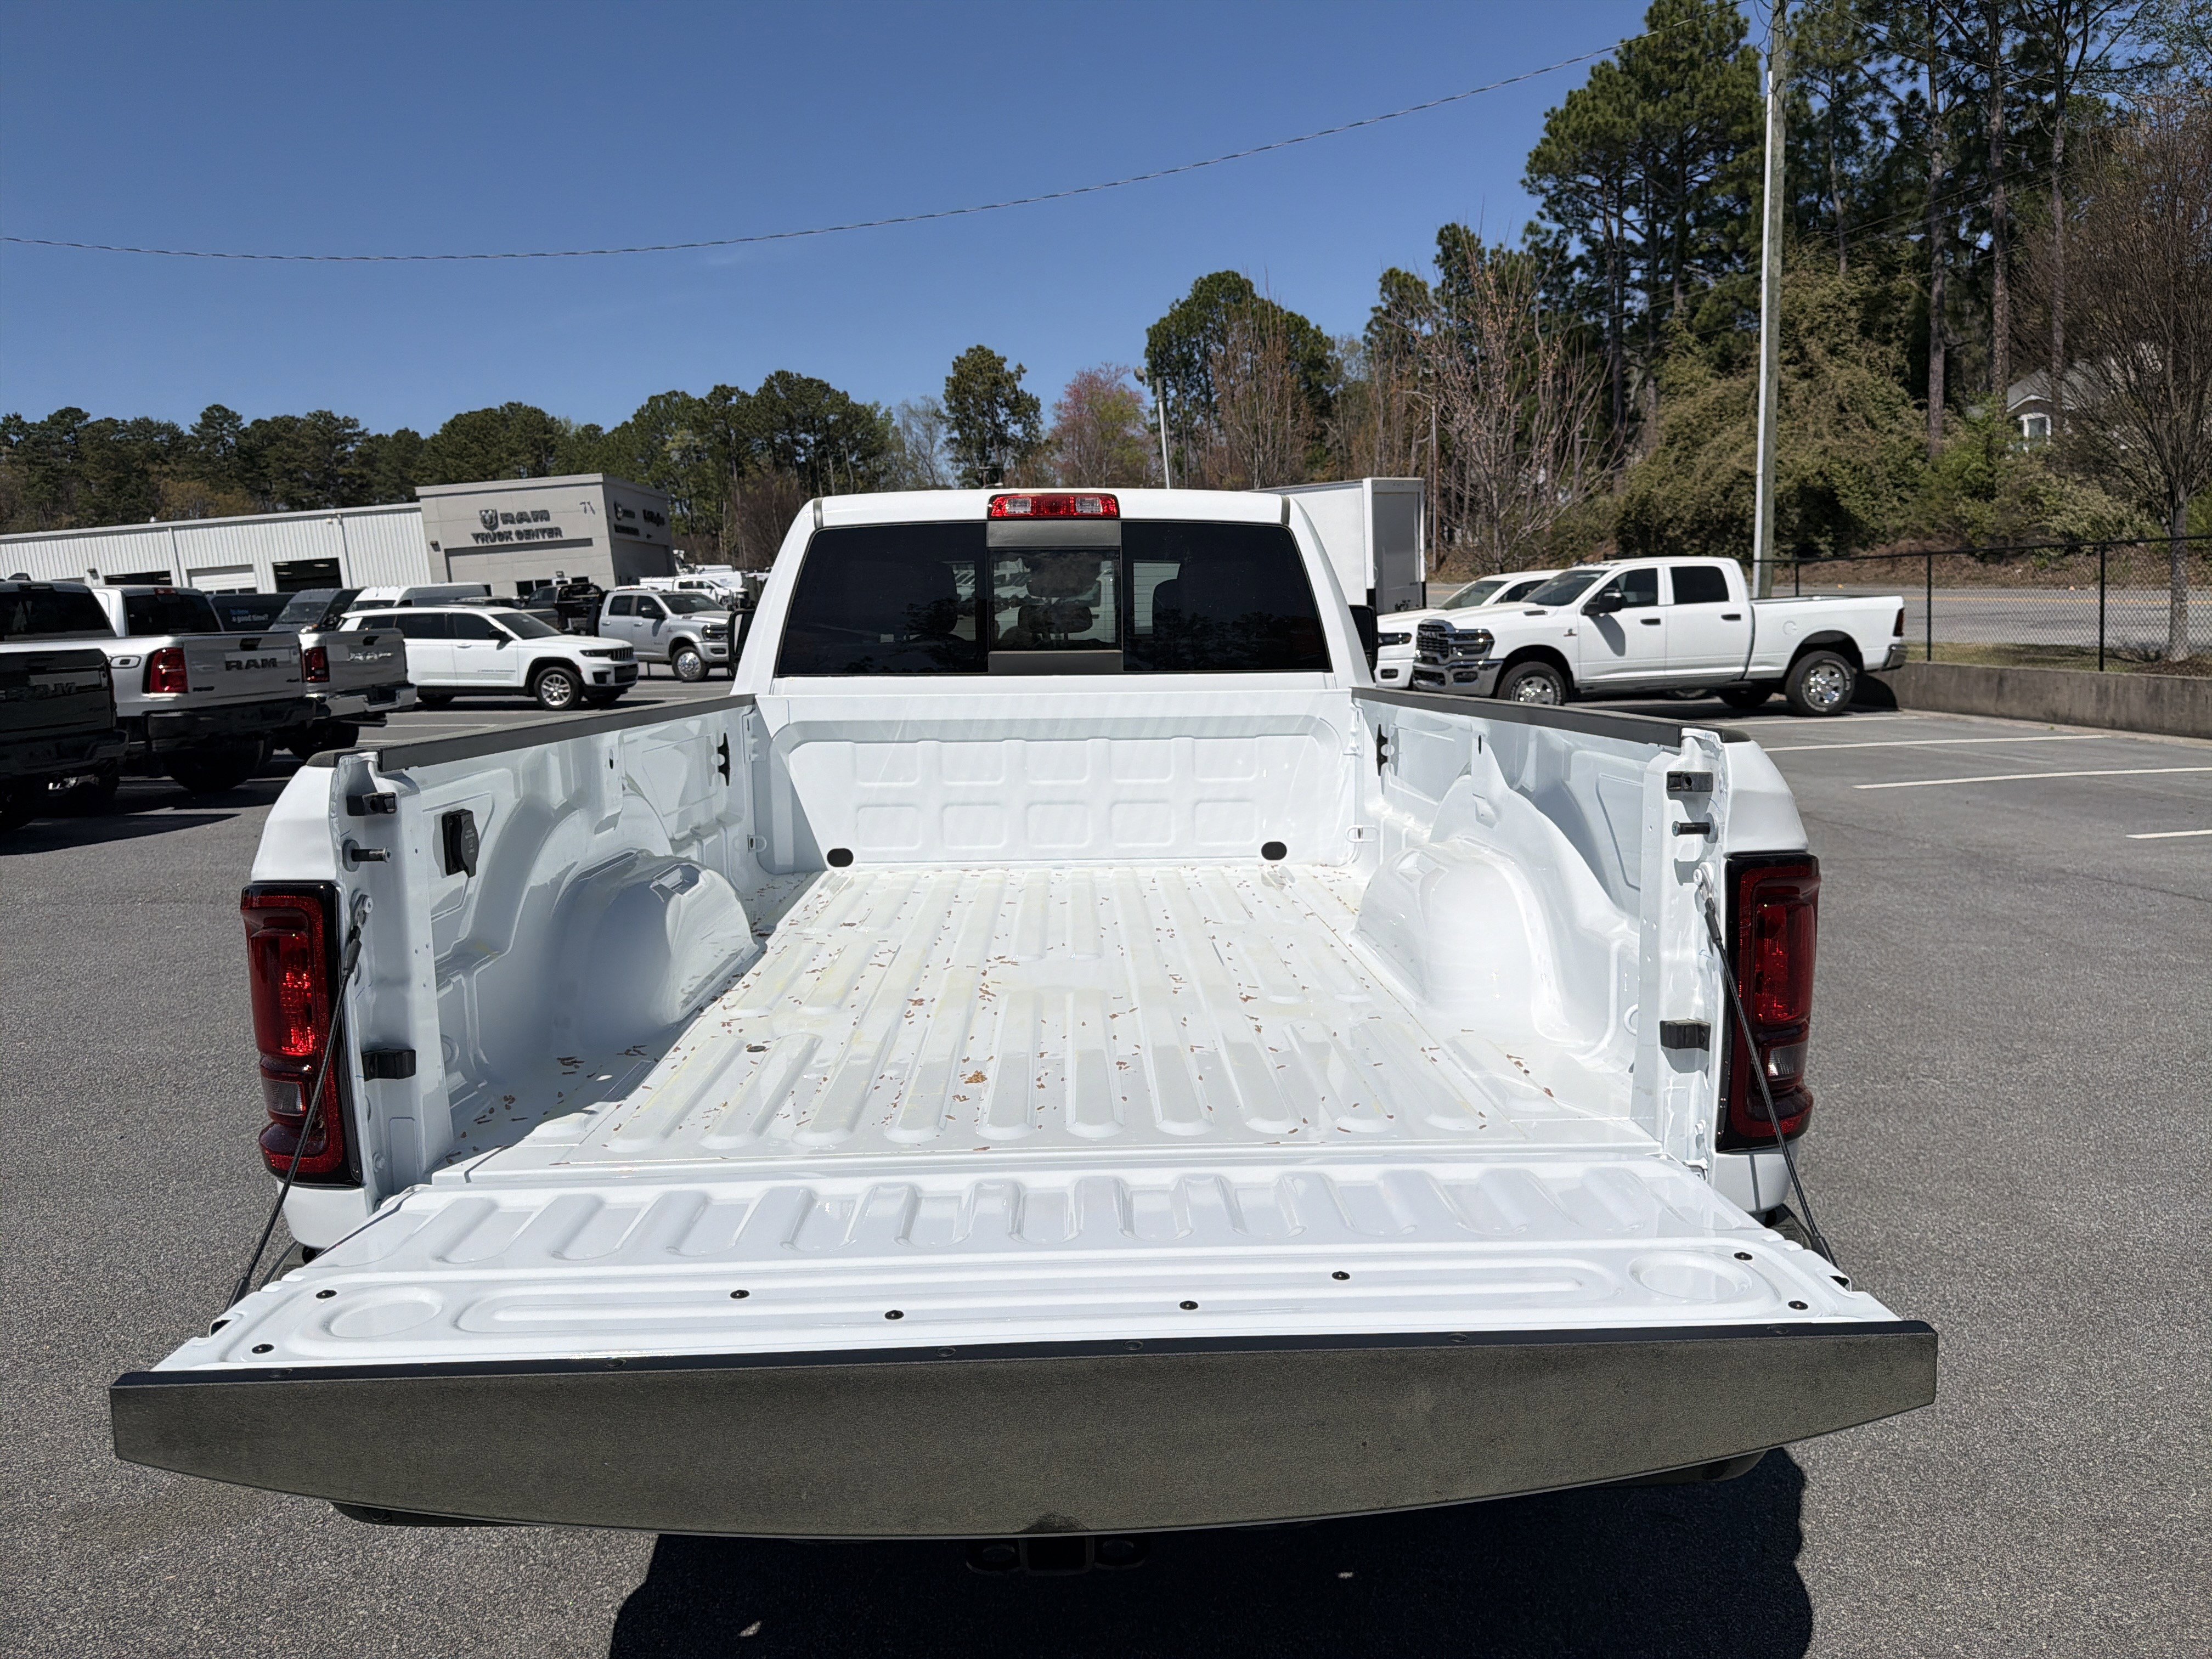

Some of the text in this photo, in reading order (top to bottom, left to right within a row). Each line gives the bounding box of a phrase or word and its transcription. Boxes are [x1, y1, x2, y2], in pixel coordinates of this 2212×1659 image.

[500, 510, 551, 525] RAM
[471, 527, 563, 545] TRUCK CENTER
[225, 658, 278, 671] RAM
